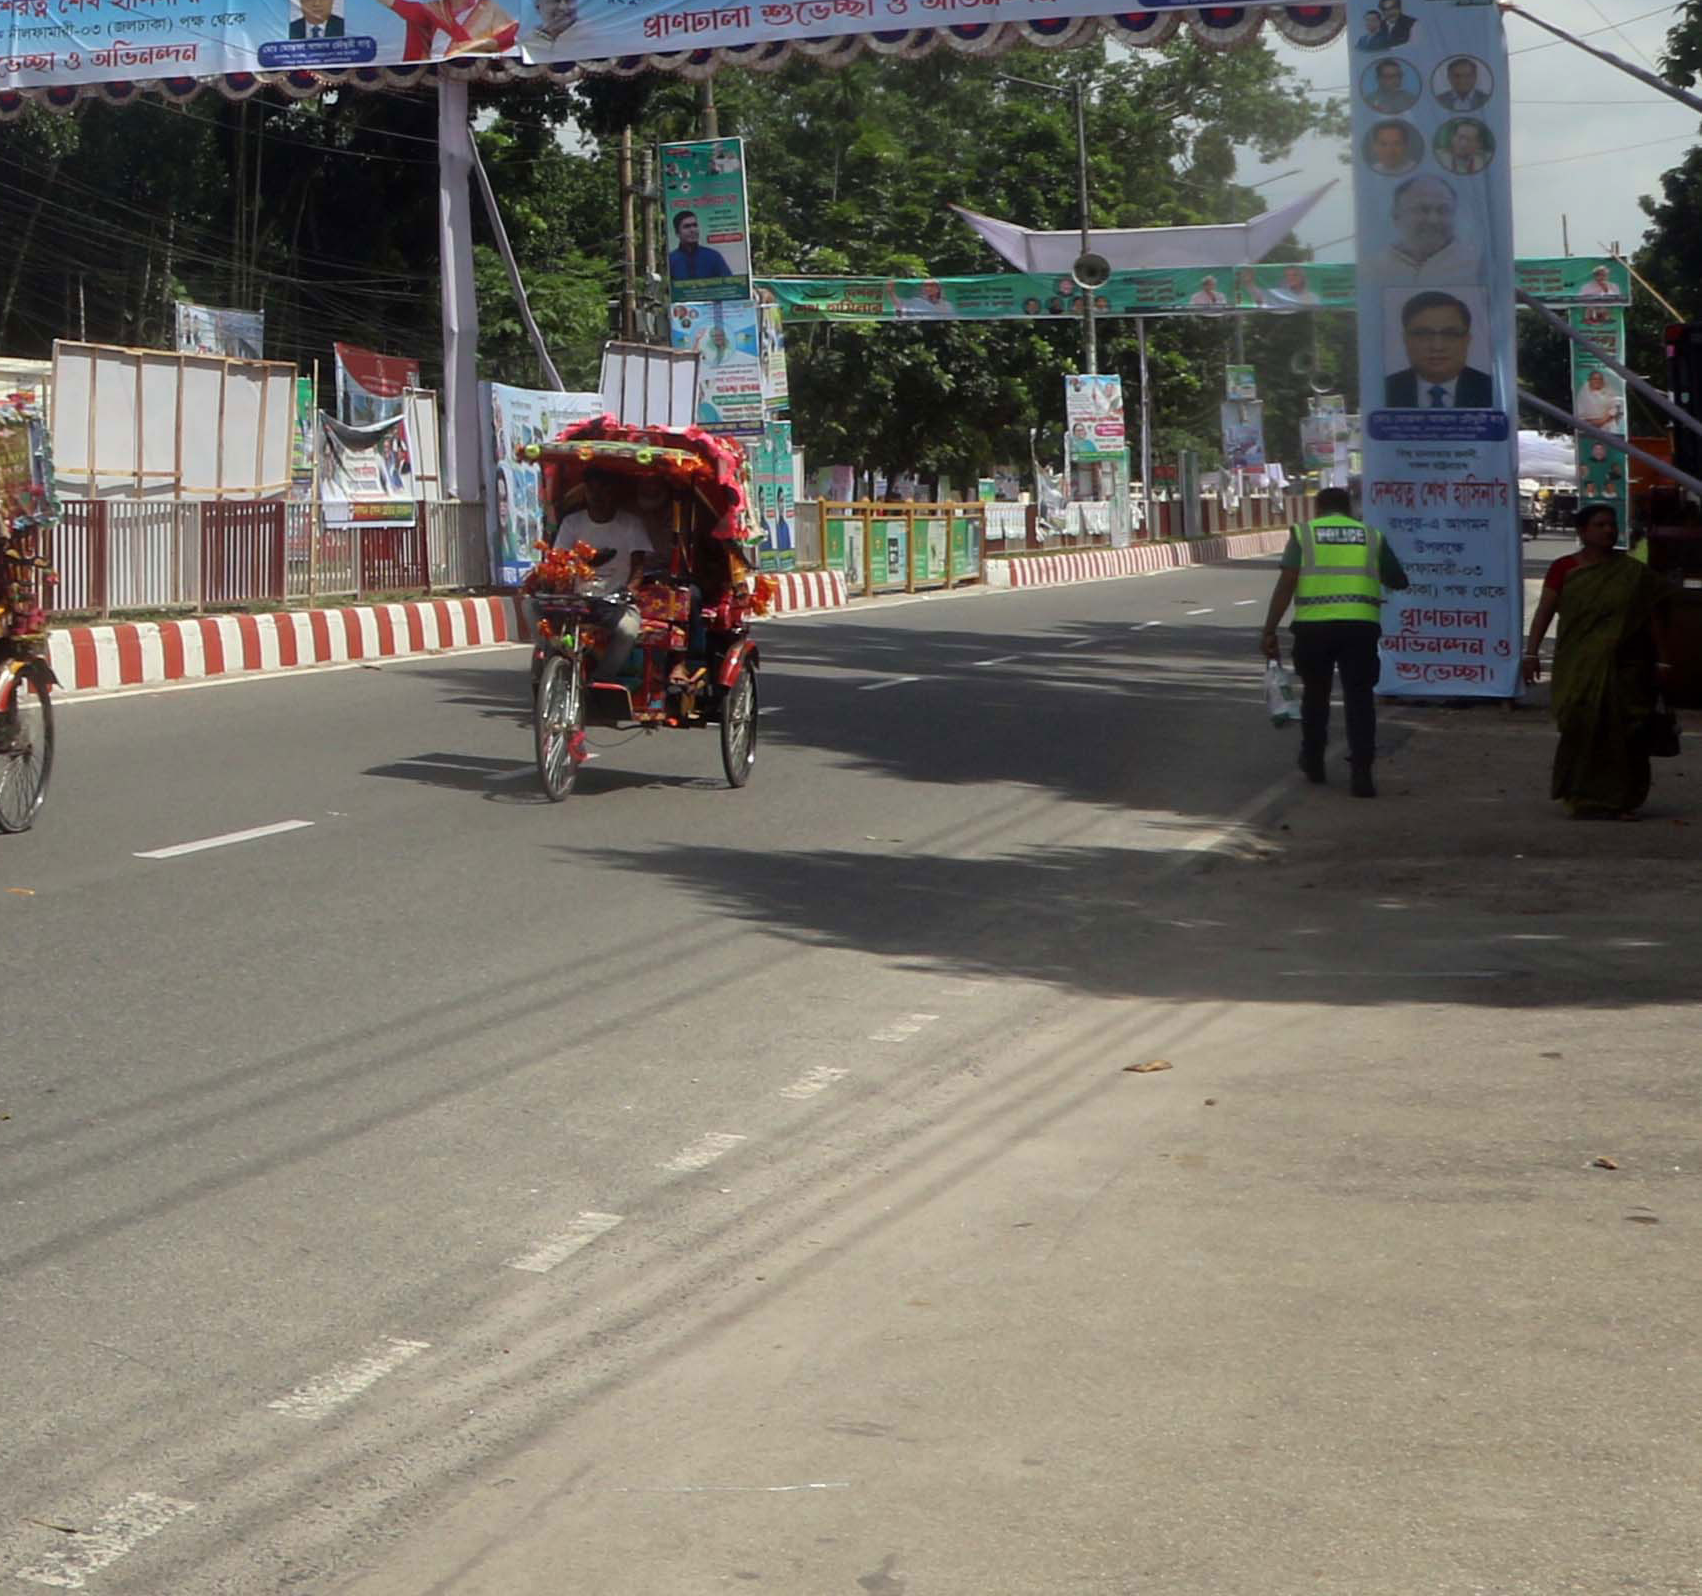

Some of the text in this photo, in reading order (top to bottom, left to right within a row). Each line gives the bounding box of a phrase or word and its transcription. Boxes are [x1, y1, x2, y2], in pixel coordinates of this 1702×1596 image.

[180, 14, 204, 29] পক্ষ
[211, 12, 247, 28] থেকে
[644, 4, 752, 38] প্রাণঢালা
[65, 51, 82, 69] ও
[90, 39, 200, 67] অভিনন্দন
[1316, 527, 1365, 542] POLICE
[1400, 607, 1489, 631] প্রাণঢালা
[1494, 641, 1512, 657] ও
